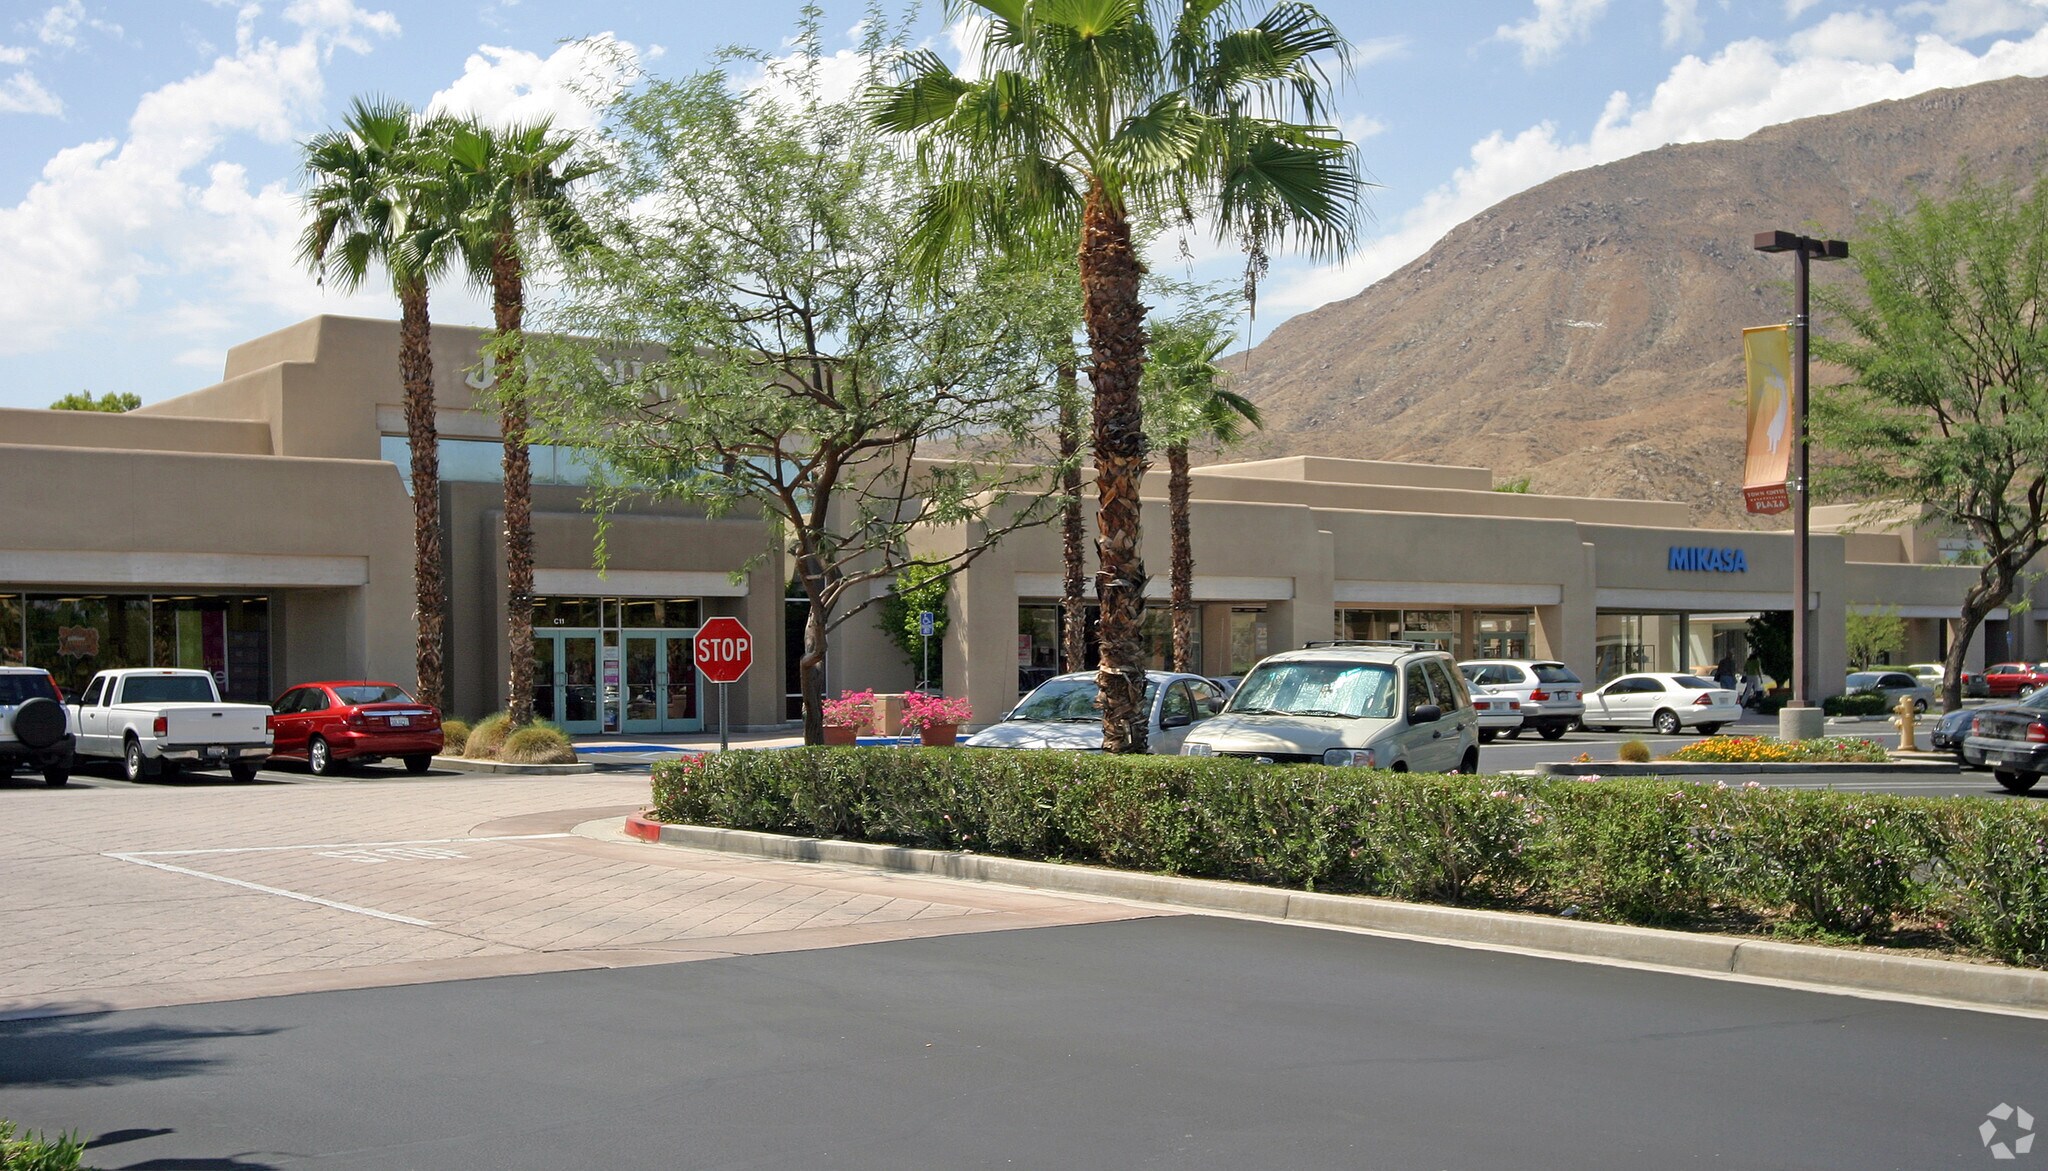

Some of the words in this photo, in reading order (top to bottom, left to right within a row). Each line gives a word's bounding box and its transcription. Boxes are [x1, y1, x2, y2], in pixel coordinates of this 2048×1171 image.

[1756, 500, 1785, 510] PLAZA
[1668, 546, 1748, 573] MIKASA
[698, 637, 748, 662] STOP
